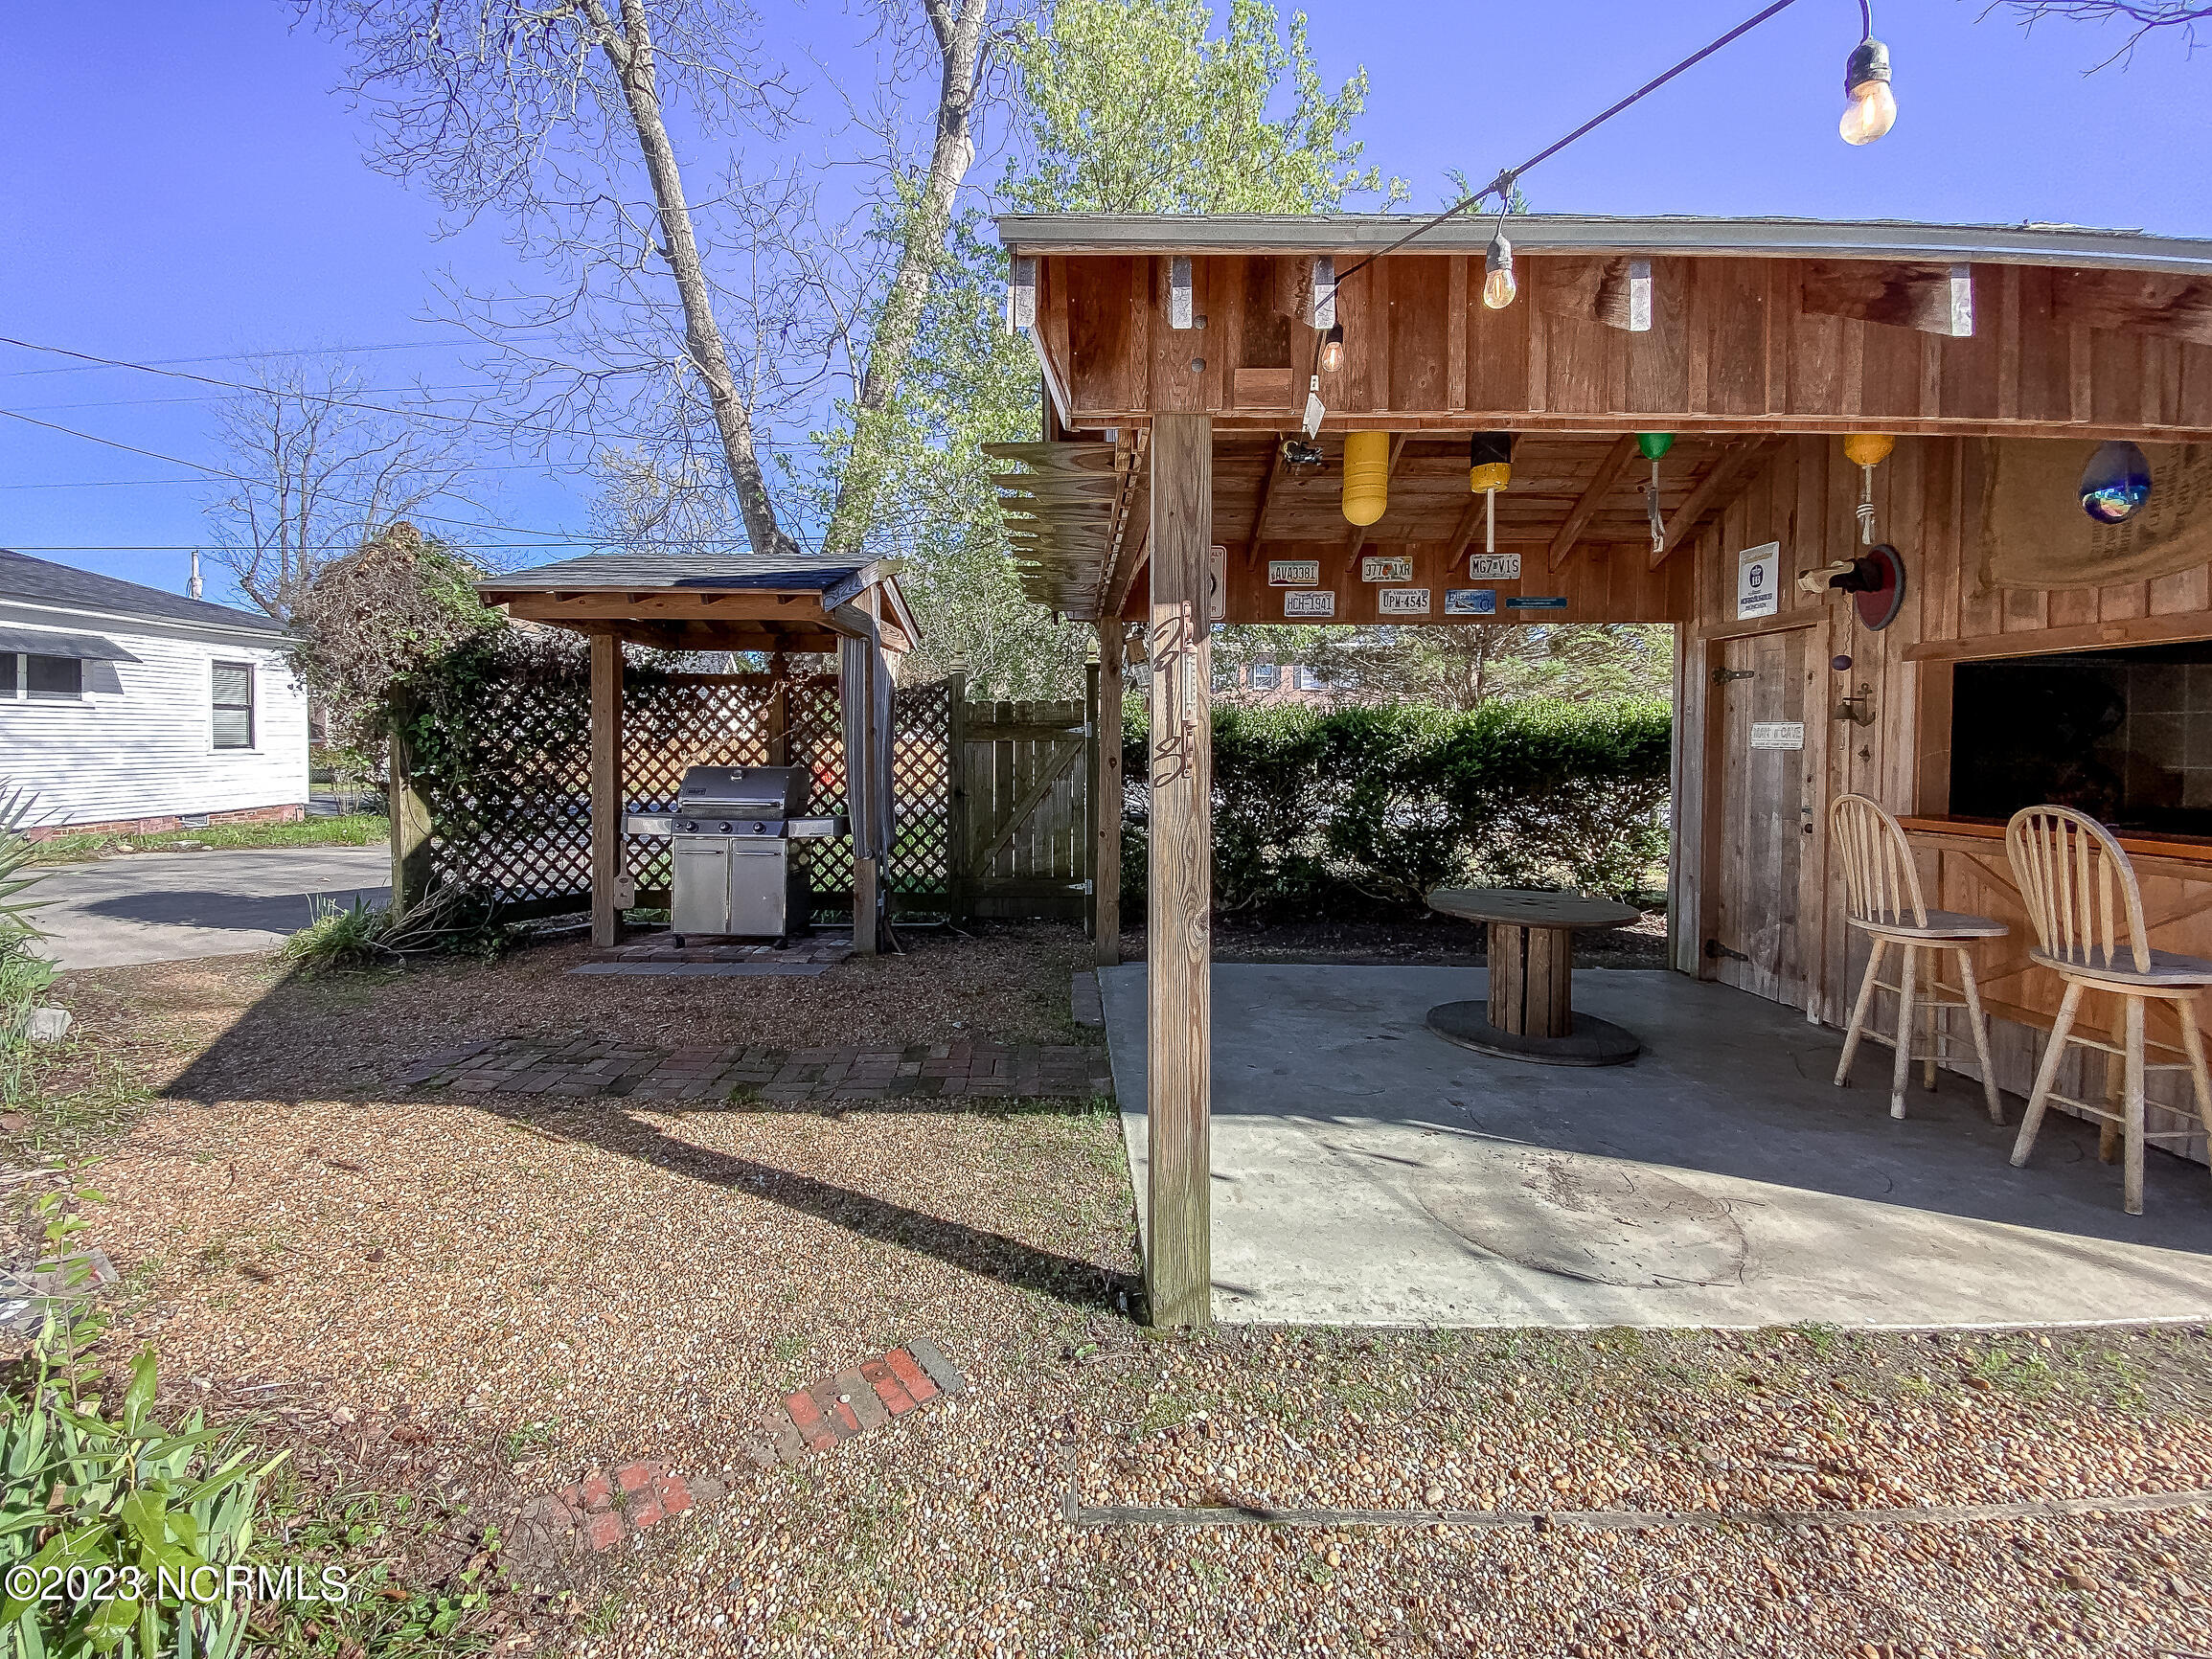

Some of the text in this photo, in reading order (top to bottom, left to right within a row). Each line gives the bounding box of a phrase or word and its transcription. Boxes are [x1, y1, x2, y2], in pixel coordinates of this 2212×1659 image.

[1275, 566, 1315, 580] AVA3381
[1472, 559, 1493, 573] MG7
[1287, 597, 1332, 610] HCH-1941
